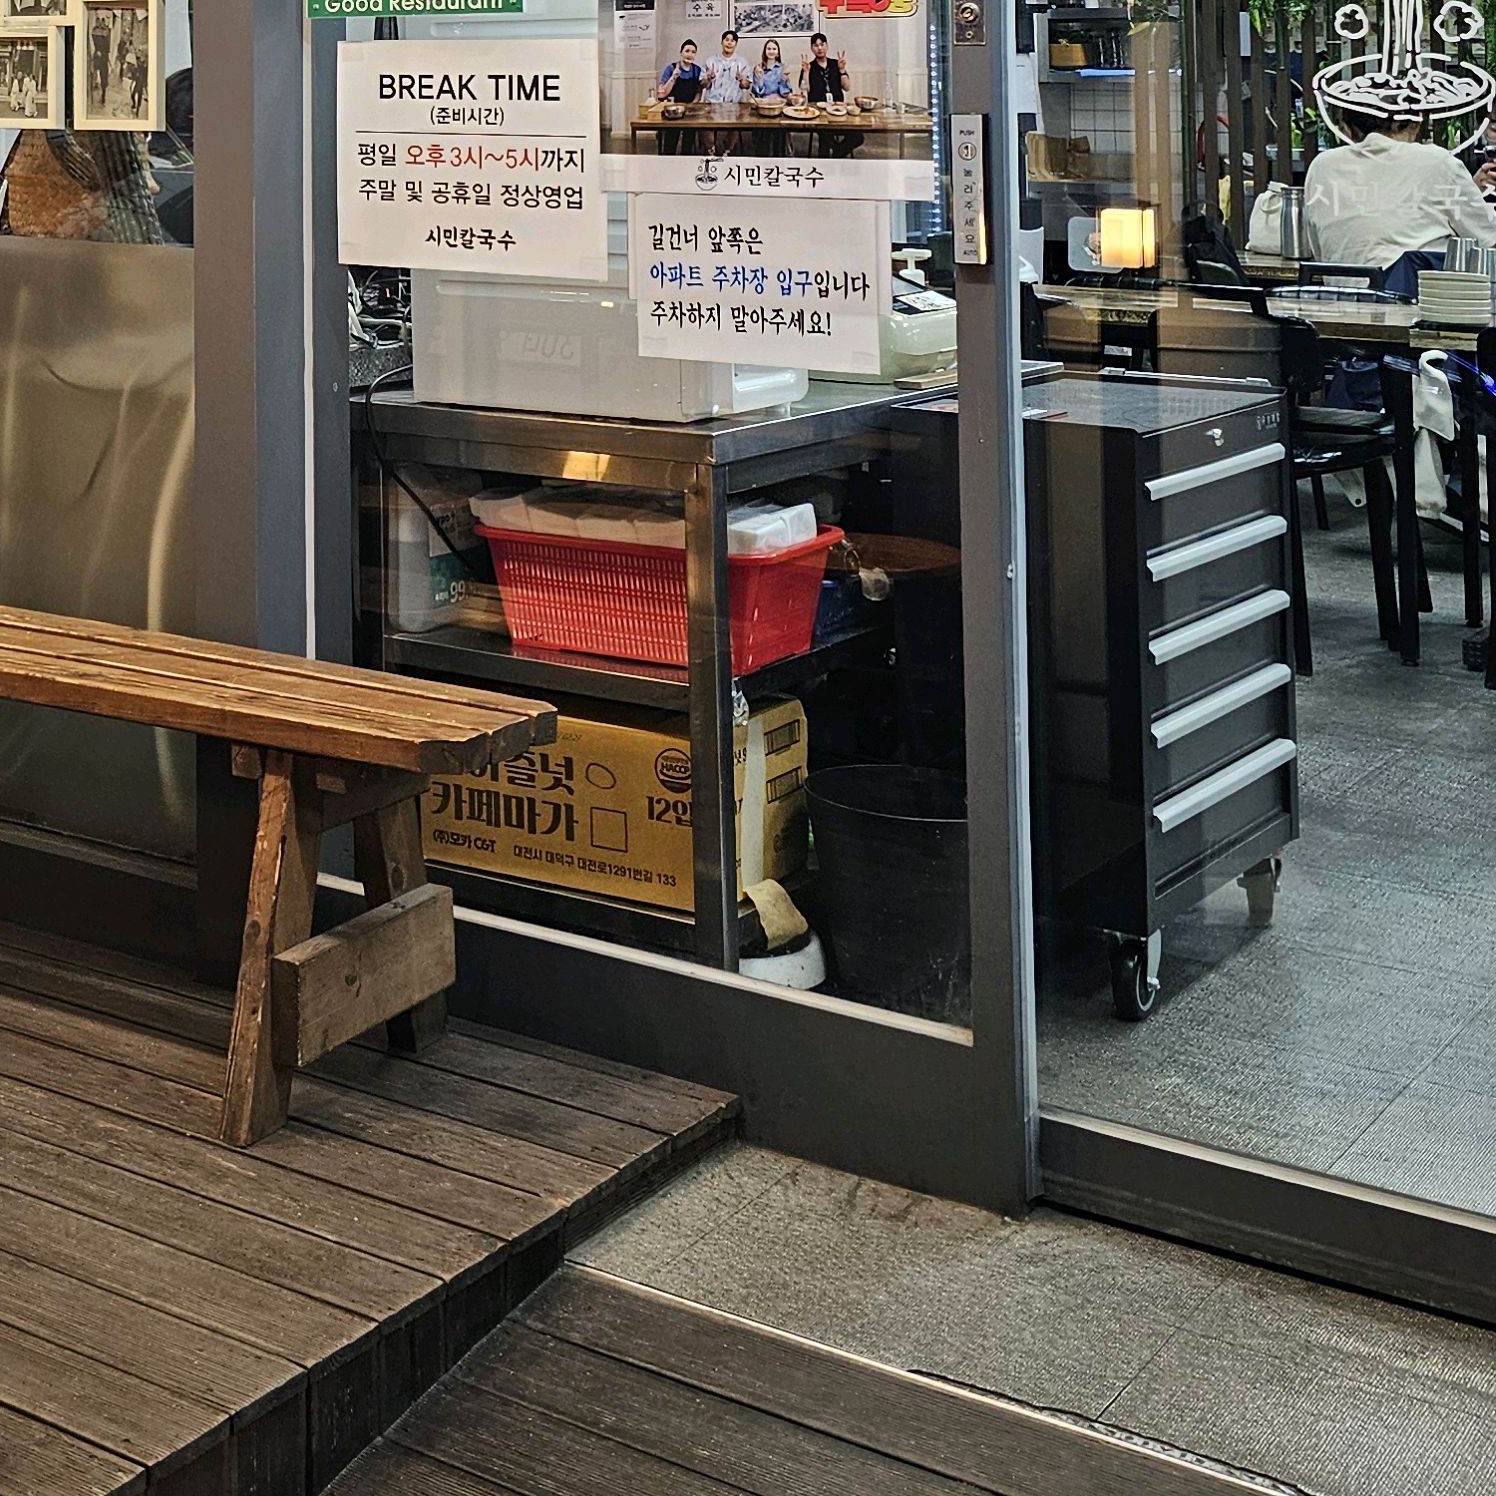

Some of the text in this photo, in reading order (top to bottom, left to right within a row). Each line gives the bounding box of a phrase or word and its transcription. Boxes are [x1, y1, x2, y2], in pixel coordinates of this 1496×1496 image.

[379, 75, 560, 101] BREAK TIME
[430, 106, 505, 126] (준비시간)
[358, 143, 396, 167] 평일
[724, 165, 824, 189] 시민칼국수
[359, 179, 583, 210] 주말 및 공휴일 정상영업
[425, 226, 516, 252] 시민칼국수
[648, 224, 763, 255] 길건너 앞쪽은
[650, 262, 870, 300] 아파트 주차장 입구입니다
[651, 301, 832, 336] 주차하지 말아주세요!
[661, 762, 690, 774] HACCP
[431, 781, 579, 841] 카페마가
[433, 829, 472, 848] (주)모카
[514, 845, 677, 887] 대전시 대덕구 대전로1291번길 133
